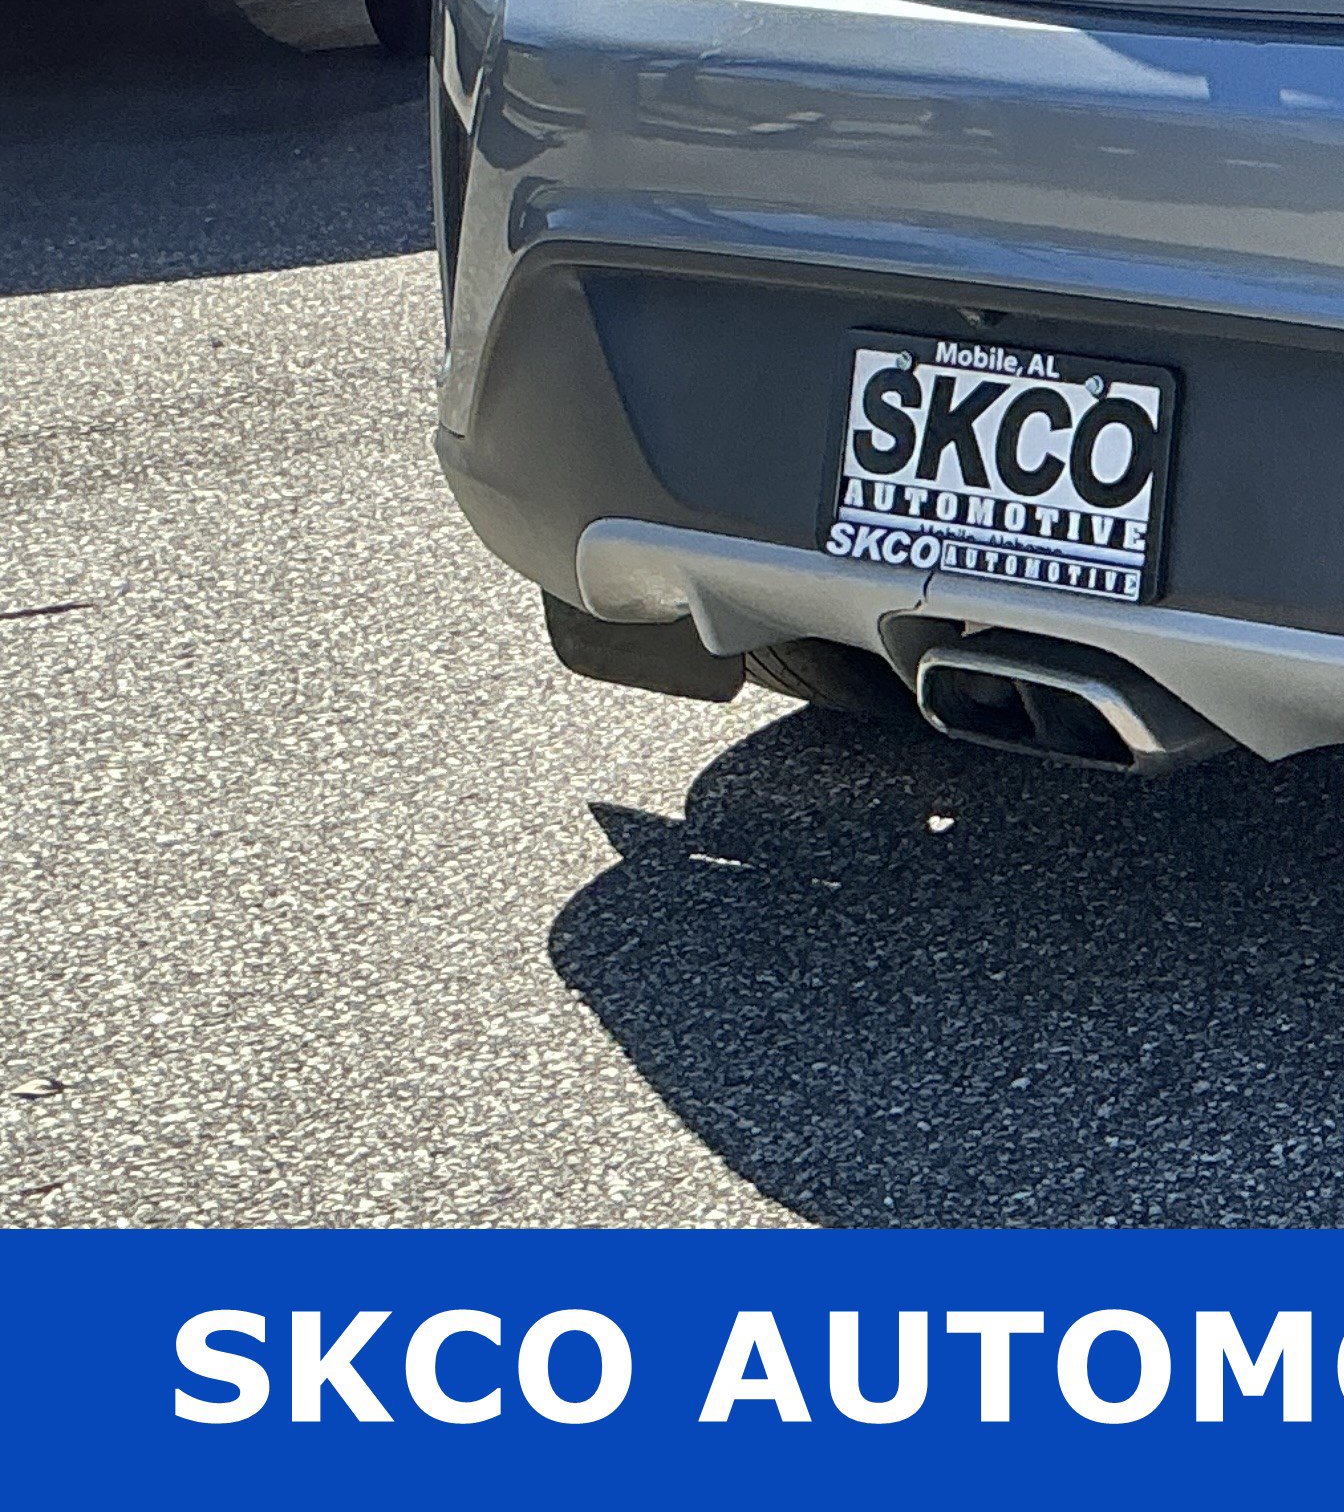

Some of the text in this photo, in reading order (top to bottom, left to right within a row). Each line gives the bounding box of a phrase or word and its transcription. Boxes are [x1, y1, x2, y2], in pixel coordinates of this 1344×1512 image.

[935, 341, 1061, 379] Mobile, AL
[853, 366, 1160, 509] SKCO
[843, 478, 1148, 551] AUTOMOTIVE
[826, 522, 1139, 596] SKCO AUTOMOTIVE
